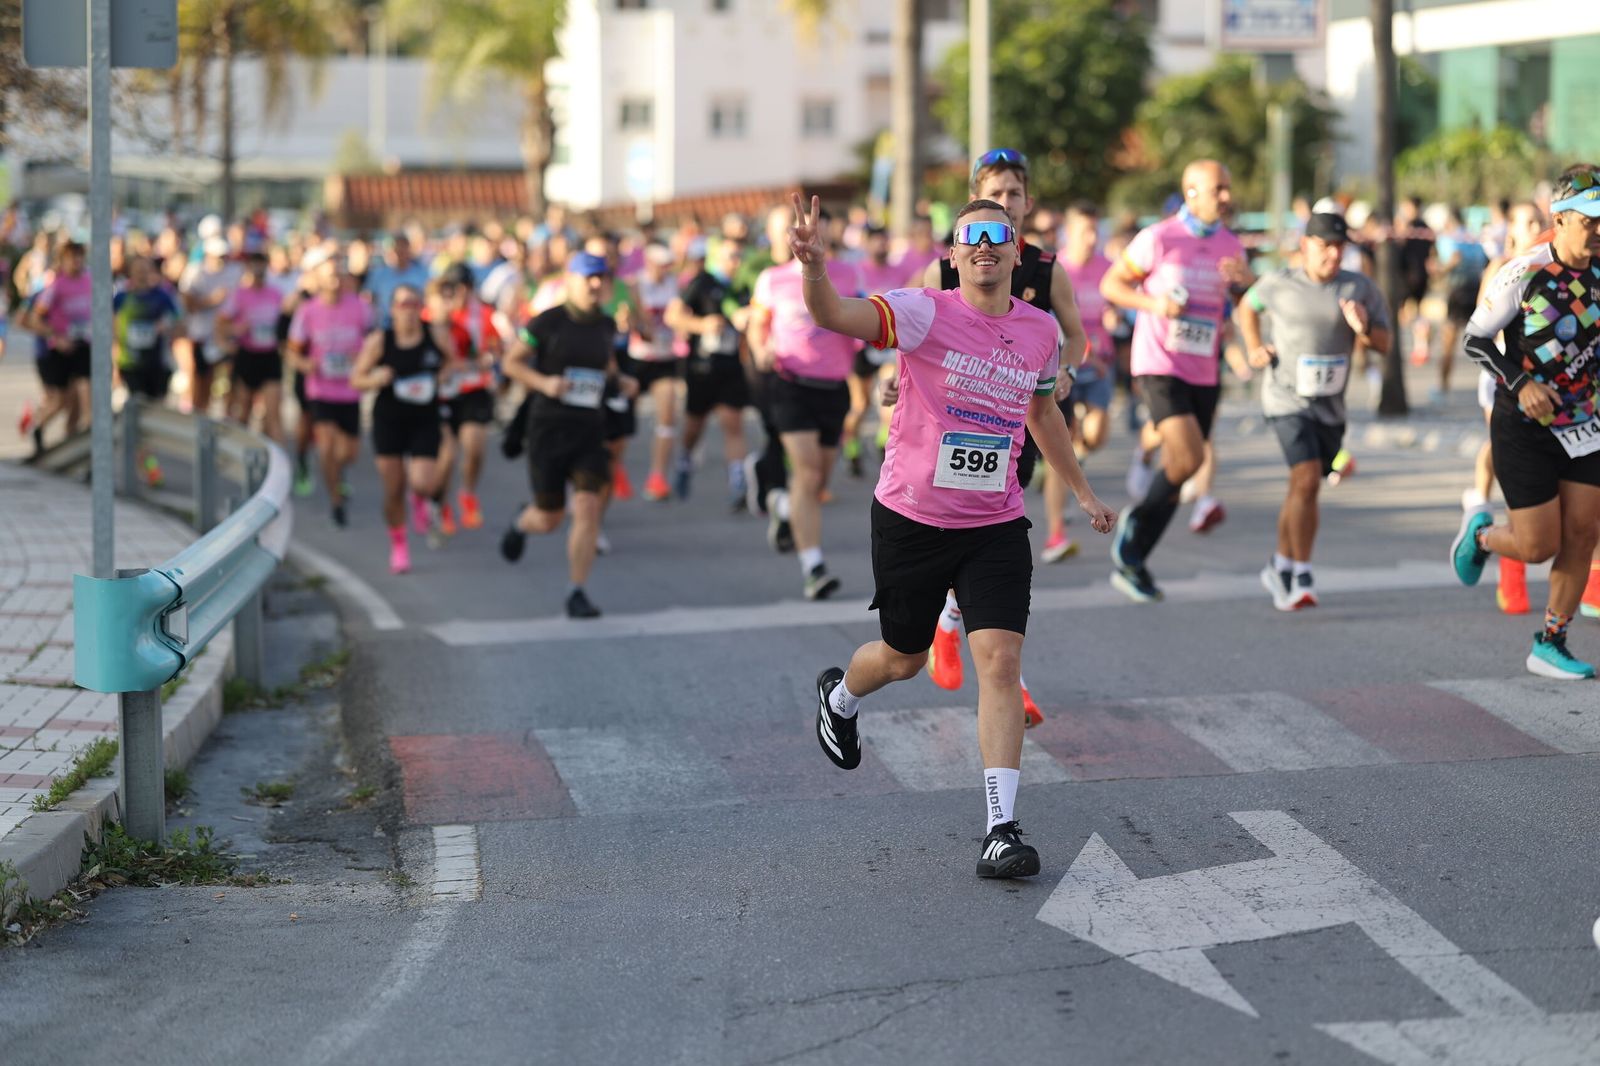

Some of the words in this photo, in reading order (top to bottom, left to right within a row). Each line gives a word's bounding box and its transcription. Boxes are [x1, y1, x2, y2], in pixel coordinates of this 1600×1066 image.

[941, 350, 992, 379] MEDIA
[945, 373, 1020, 403] INTERNACIONAL
[949, 447, 999, 473] 598
[987, 776, 1003, 822] UNDER
